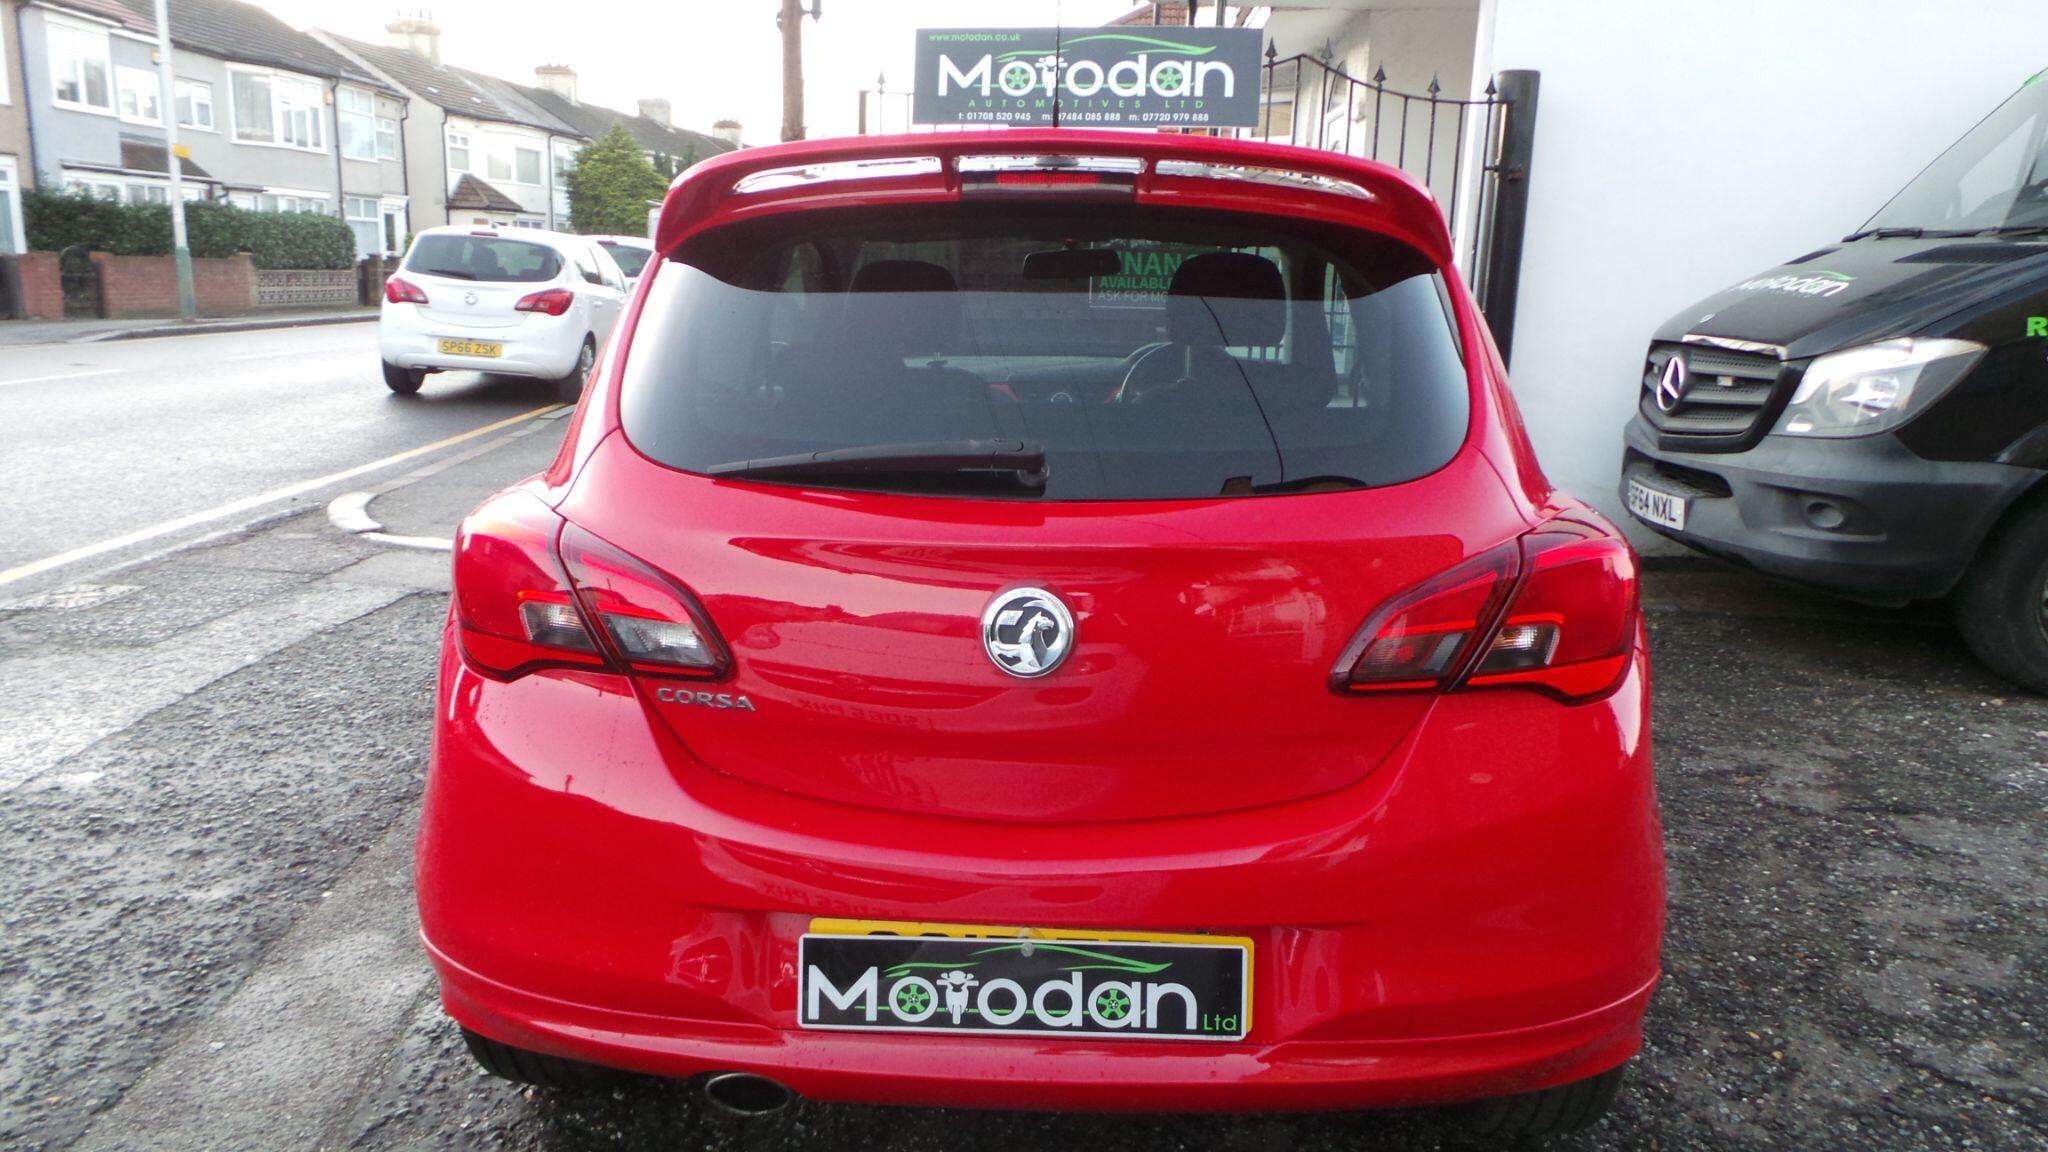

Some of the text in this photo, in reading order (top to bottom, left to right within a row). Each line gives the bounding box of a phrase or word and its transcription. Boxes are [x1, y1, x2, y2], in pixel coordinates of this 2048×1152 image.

[928, 32, 1021, 41] www.motodan.co.uk
[1165, 100, 1204, 109] LTD
[967, 112, 993, 120] 01708
[996, 112, 1012, 120] 520
[1015, 112, 1031, 120] 945
[1104, 113, 1121, 121] 888
[1142, 113, 1170, 121] 07720
[1173, 113, 1190, 121] 979
[1192, 114, 1209, 122] 888
[1122, 251, 1186, 276] NAN
[1098, 291, 1120, 302] ASK
[1124, 292, 1148, 302] FOR
[2026, 316, 2048, 336] R
[442, 341, 471, 353] SP66
[1652, 494, 1676, 521] NXL
[657, 687, 756, 712] CORSA
[808, 964, 1237, 1031] Motodan Ltd
